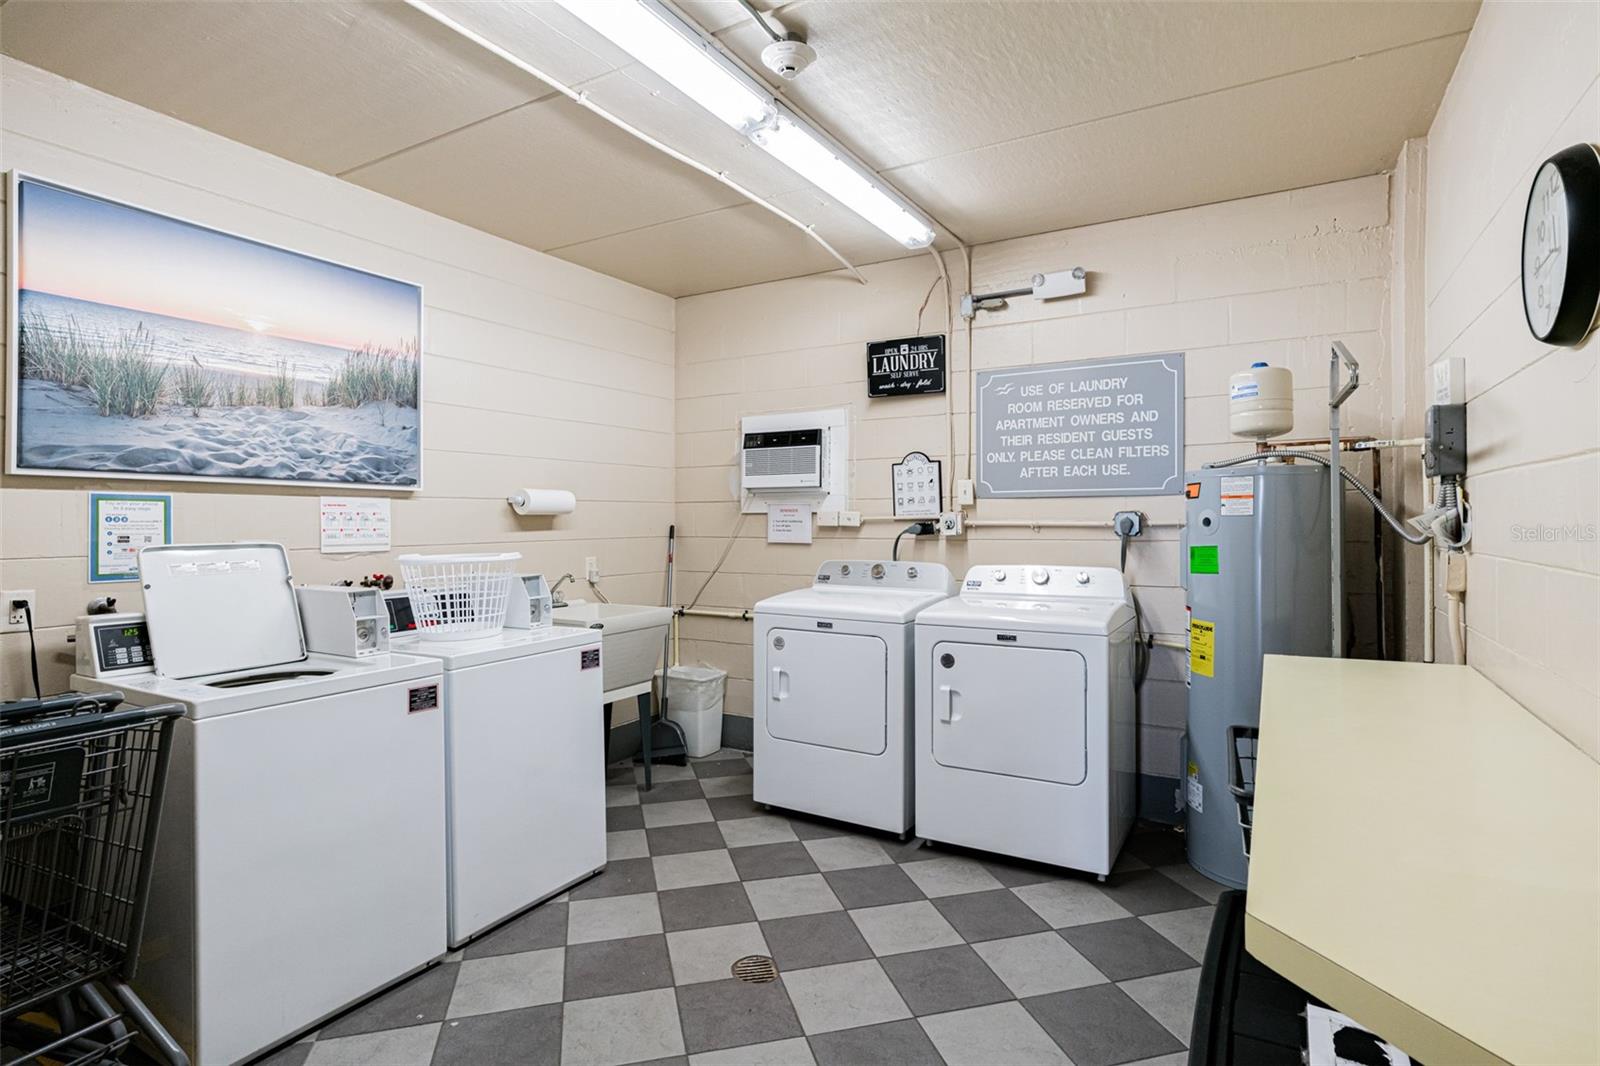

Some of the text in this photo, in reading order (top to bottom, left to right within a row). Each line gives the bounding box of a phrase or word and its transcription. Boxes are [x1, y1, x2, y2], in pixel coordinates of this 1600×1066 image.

[873, 352, 937, 373] LAUNDRY
[890, 370, 919, 379] SELF SERVE
[1020, 377, 1128, 397] USE OF LAUNDRY
[1008, 394, 1144, 414] ROOM RESERVED FOR
[995, 410, 1159, 430] APARTMENT OWNERS AND
[1000, 428, 1153, 447] THEIR RESIDENT GUESTS
[986, 445, 1169, 464] ONLY. PLEASE CLEAN FILTERS
[1020, 464, 1130, 478] AFTER EACH USE.
